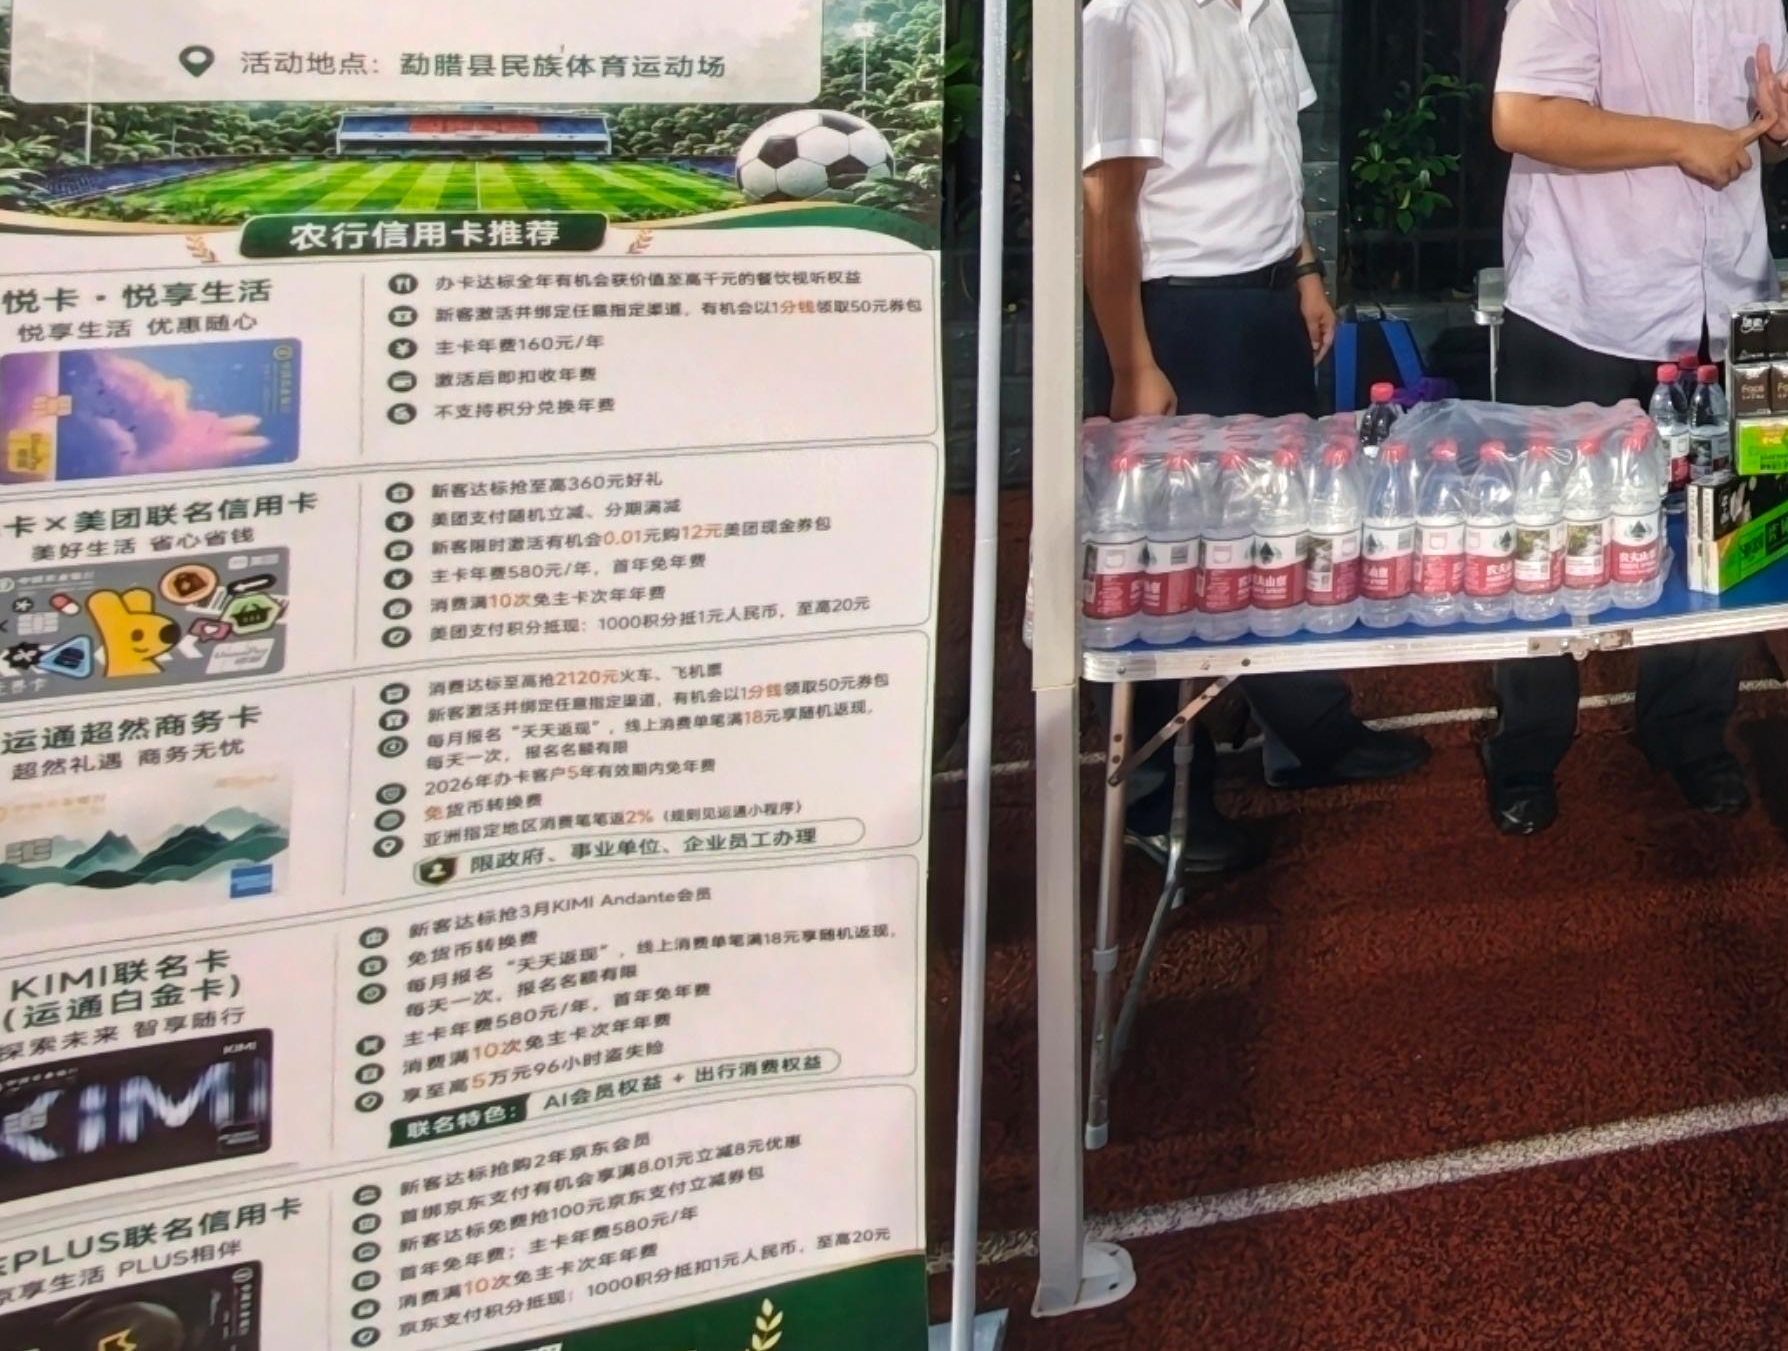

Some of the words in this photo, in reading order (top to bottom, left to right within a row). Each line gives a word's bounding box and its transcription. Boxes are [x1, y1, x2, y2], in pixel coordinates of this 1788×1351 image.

[289, 220, 560, 250] 农行信用卡推荐
[18, 319, 133, 343] 悦享生活
[147, 313, 258, 336] 优惠随心
[435, 333, 605, 355] 主卡年费160元/年
[435, 366, 597, 388] 激活后即扣收年费
[435, 398, 616, 420] 不支持积分兑换年费
[431, 471, 663, 499] 新客达标抢至高360元好礼
[3, 492, 318, 538] 卡×美团联名信用卡
[32, 537, 136, 562] 美好生活
[150, 526, 255, 552] 省心省钱
[430, 585, 666, 613] 消费满10次免主卡次年年费
[1, 705, 262, 754] 运通超然商务卡
[12, 751, 123, 781] 超然礼遇
[138, 738, 245, 767] 商务无忧
[424, 758, 716, 796] 2026年办卡客户5年有效期内免年费
[423, 792, 543, 822] 免货币转换费
[470, 827, 817, 874] 限政府、事业单位、企业员工办理
[408, 893, 594, 939] 新客达标抢3月KIMI
[600, 886, 712, 908] Andante会员
[408, 929, 539, 968] 免货币转换费
[11, 949, 231, 1000] KIMI联名卡
[133, 1006, 245, 1038] 智享随行
[403, 1012, 672, 1075] 消费满10次免主卡次年年费
[543, 1073, 663, 1111] AI会员权益
[695, 1054, 823, 1084] 出行消费权益
[401, 1131, 652, 1196] 新客达标抢购2年京东会员
[401, 1133, 803, 1226] 首绑京东支付有机会享满8.01元立减8元优惠
[399, 1165, 765, 1254] 新客达标免费抢100元京东支付立减券包
[118, 1240, 242, 1278] PLUS相伴
[398, 1243, 659, 1312] 消费满10次免主卡次年年费
